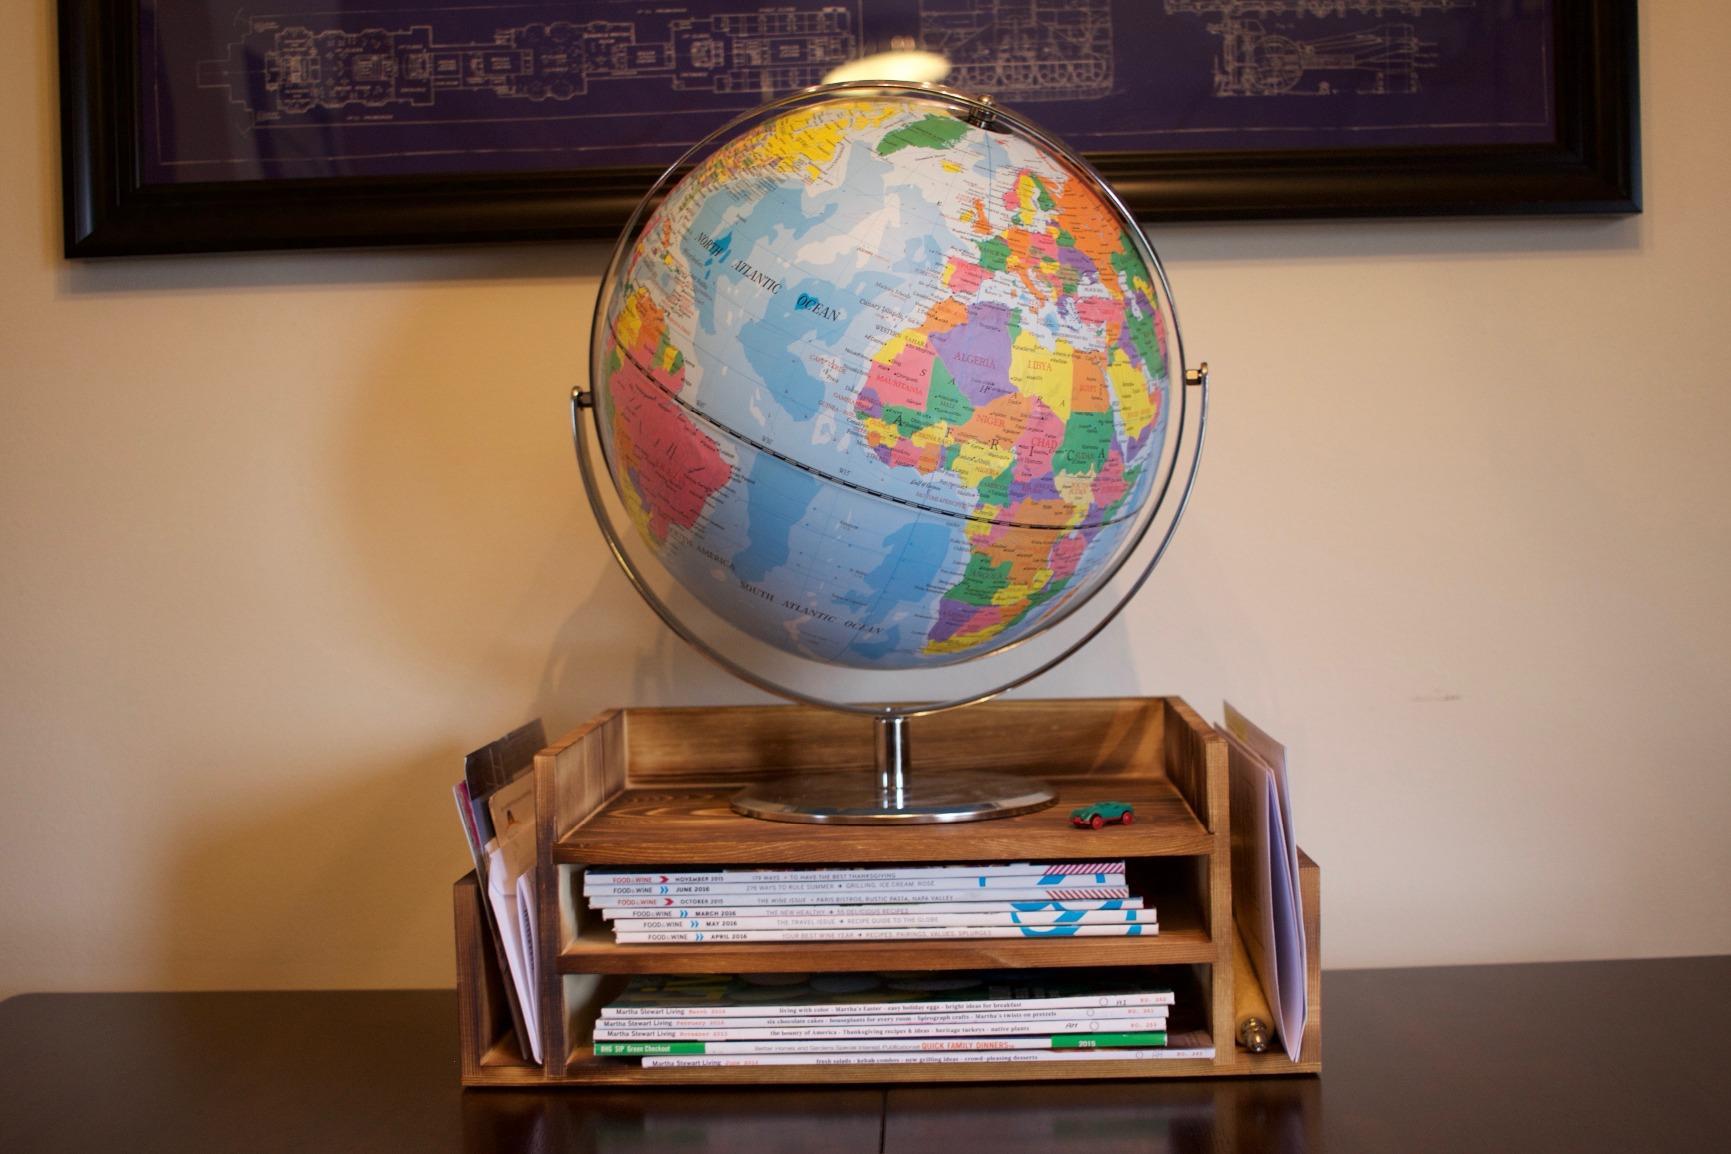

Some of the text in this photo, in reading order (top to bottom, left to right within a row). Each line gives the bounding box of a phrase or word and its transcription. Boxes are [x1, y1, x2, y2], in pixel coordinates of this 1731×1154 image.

[695, 231, 841, 322] NORTH ATLANTIC OCEAN
[953, 351, 997, 370] ALGERIA
[1027, 360, 1053, 372] LIBYA
[876, 375, 923, 395] MAURITANIA
[976, 414, 1005, 427] NIGER
[1031, 437, 1058, 449] CHAD
[739, 580, 774, 602] SOUTH
[781, 599, 836, 623] ATLANTIC
[711, 933, 730, 941] APRIL
[666, 1008, 685, 1016] Living
[902, 1004, 925, 1012] holiday
[945, 1003, 964, 1011] bright
[653, 1019, 673, 1028] Living
[807, 1017, 824, 1025] cakes
[829, 1016, 865, 1024] houseplants
[657, 1030, 676, 1038] Living
[843, 1028, 883, 1037] Thanksgiving
[921, 1042, 945, 1050] QUICK
[947, 1041, 973, 1050] FAMILY
[975, 1041, 1009, 1049] DINNERS
[702, 1059, 722, 1067] Living
[919, 1056, 942, 1064] grilling
[1013, 1053, 1038, 1061] desserts
